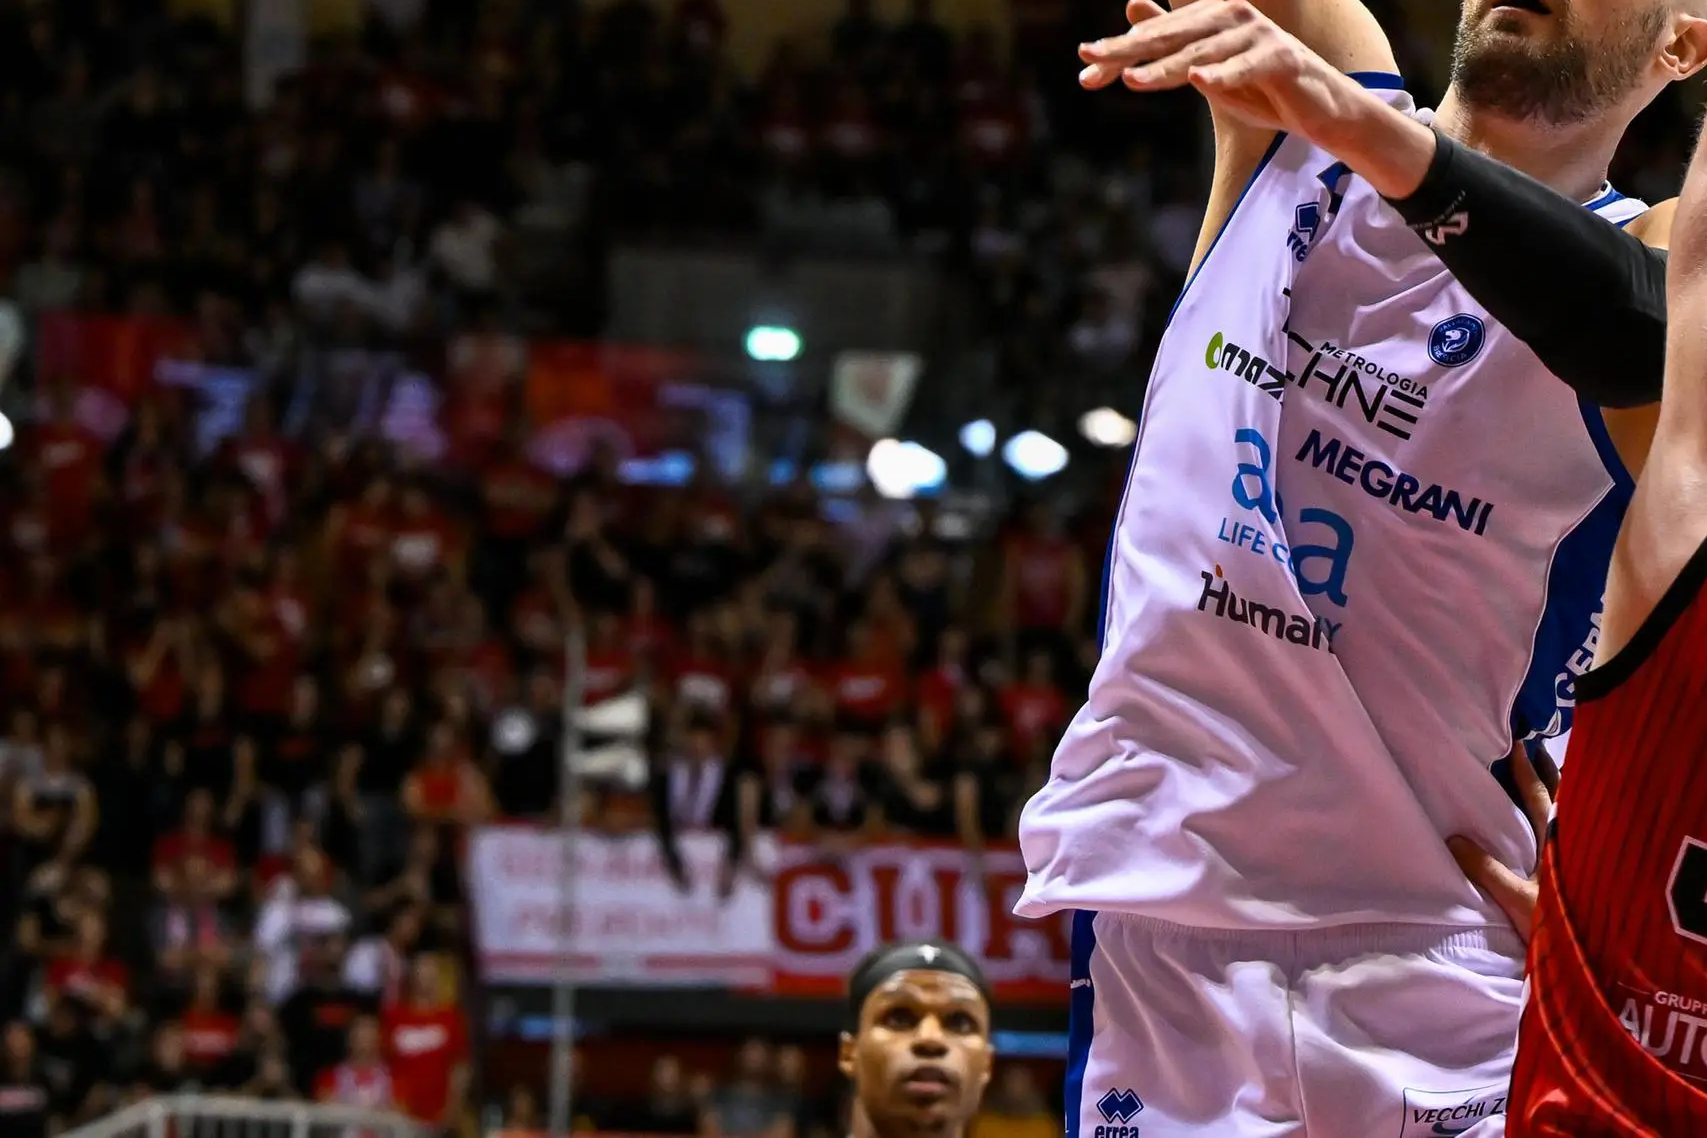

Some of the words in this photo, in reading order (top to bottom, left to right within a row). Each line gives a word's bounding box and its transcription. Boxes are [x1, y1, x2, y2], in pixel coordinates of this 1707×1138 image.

[1319, 341, 1428, 400] METROLOGIA
[1295, 429, 1494, 536] MEGRANI
[1218, 517, 1265, 555] LIFE
[1413, 1101, 1485, 1124] VECCHI
